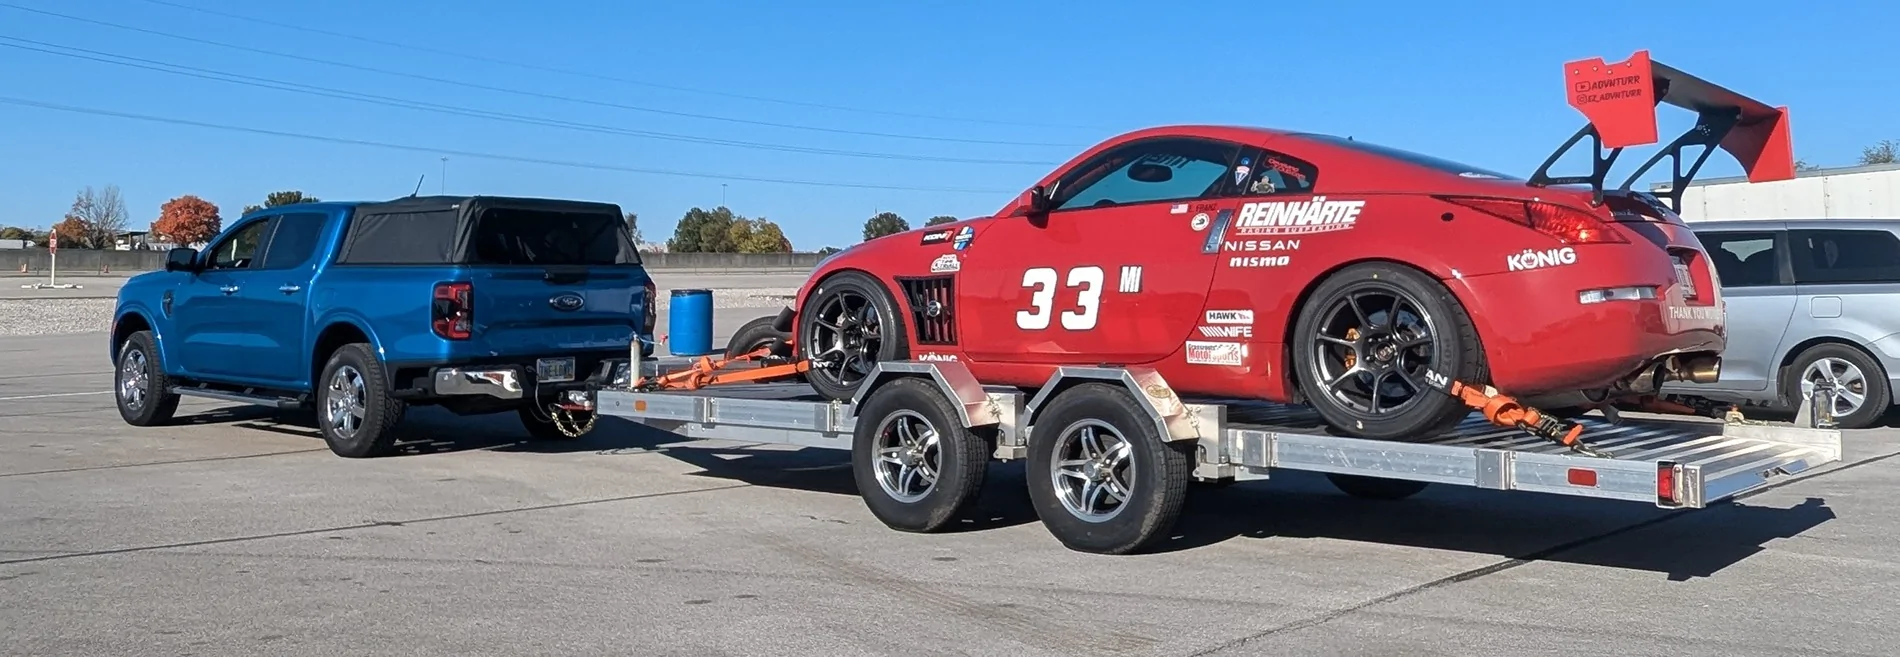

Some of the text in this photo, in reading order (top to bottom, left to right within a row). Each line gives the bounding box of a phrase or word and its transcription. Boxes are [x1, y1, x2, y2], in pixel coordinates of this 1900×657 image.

[1591, 75, 1641, 91] ADVNTURR
[1235, 195, 1366, 228] REINHÄRTE
[1224, 239, 1300, 252] NISSAN
[1229, 256, 1290, 267] nismo
[1507, 247, 1577, 272] KÖNIG
[1016, 266, 1142, 331] 33 MI
[1208, 312, 1237, 320] HAWK
[1669, 306, 1692, 319] THANK
